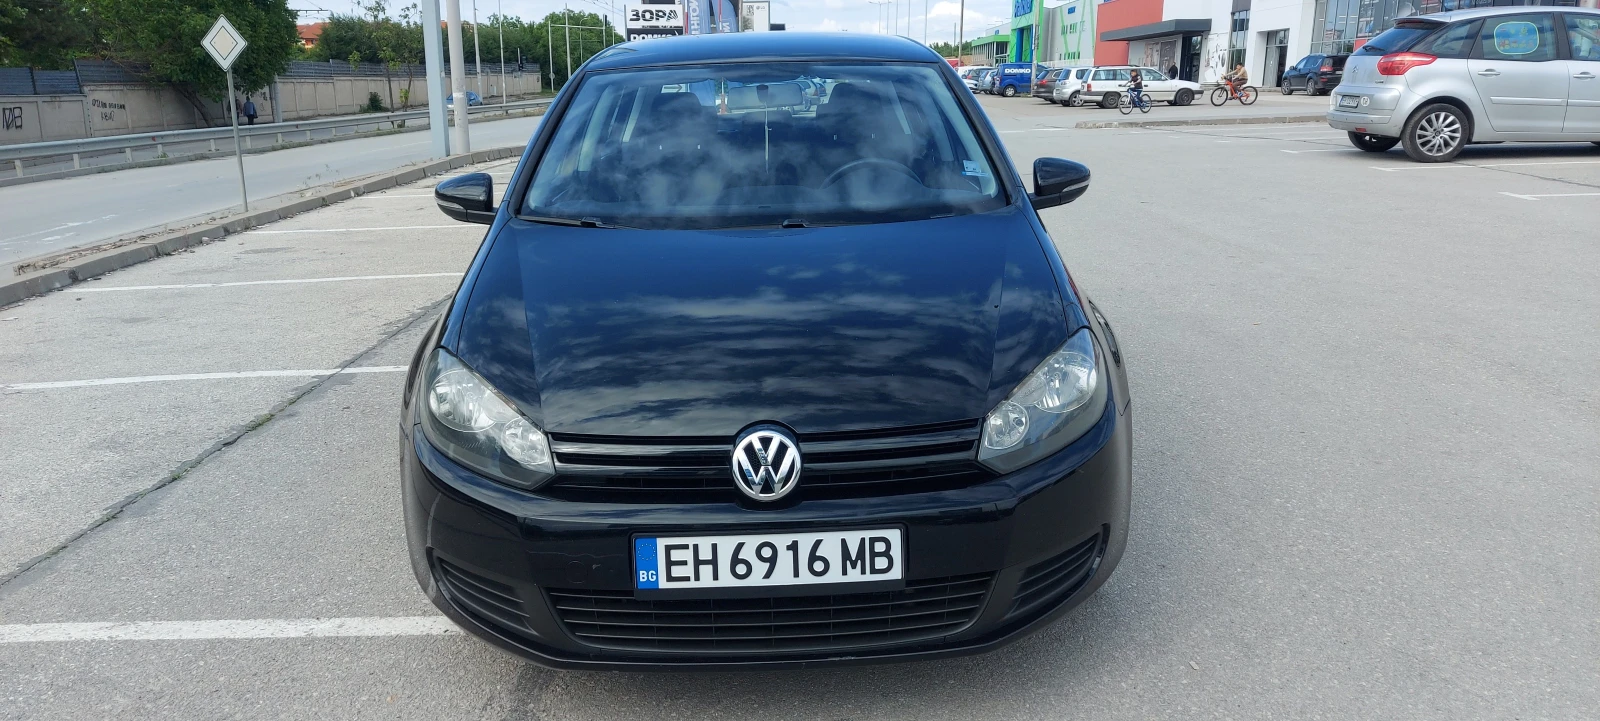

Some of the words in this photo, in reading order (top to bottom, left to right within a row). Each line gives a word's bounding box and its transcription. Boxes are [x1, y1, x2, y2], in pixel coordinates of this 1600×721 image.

[732, 430, 802, 502] VW
[639, 569, 657, 583] BG
[664, 542, 719, 583] EH
[729, 538, 830, 581] 6916
[840, 535, 894, 576] MB
